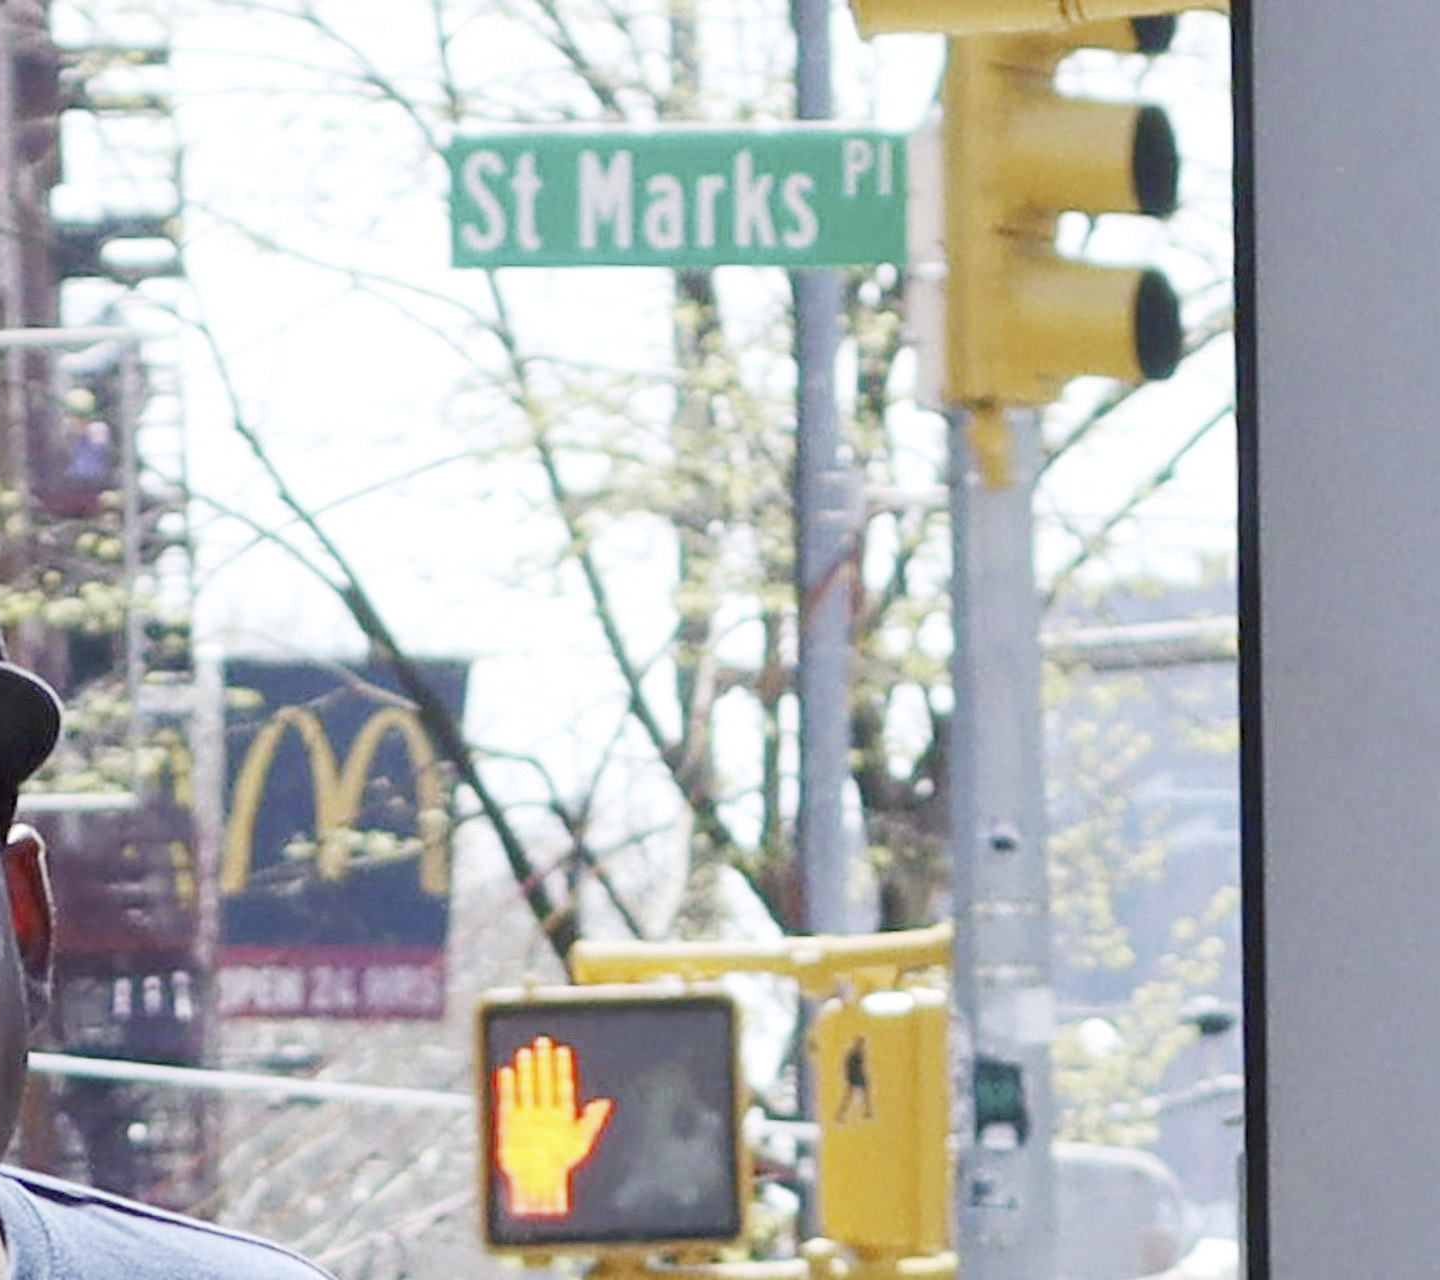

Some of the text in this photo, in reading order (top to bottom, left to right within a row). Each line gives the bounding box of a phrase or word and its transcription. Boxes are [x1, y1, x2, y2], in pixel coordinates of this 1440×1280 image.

[461, 138, 895, 253] St Marks Pl
